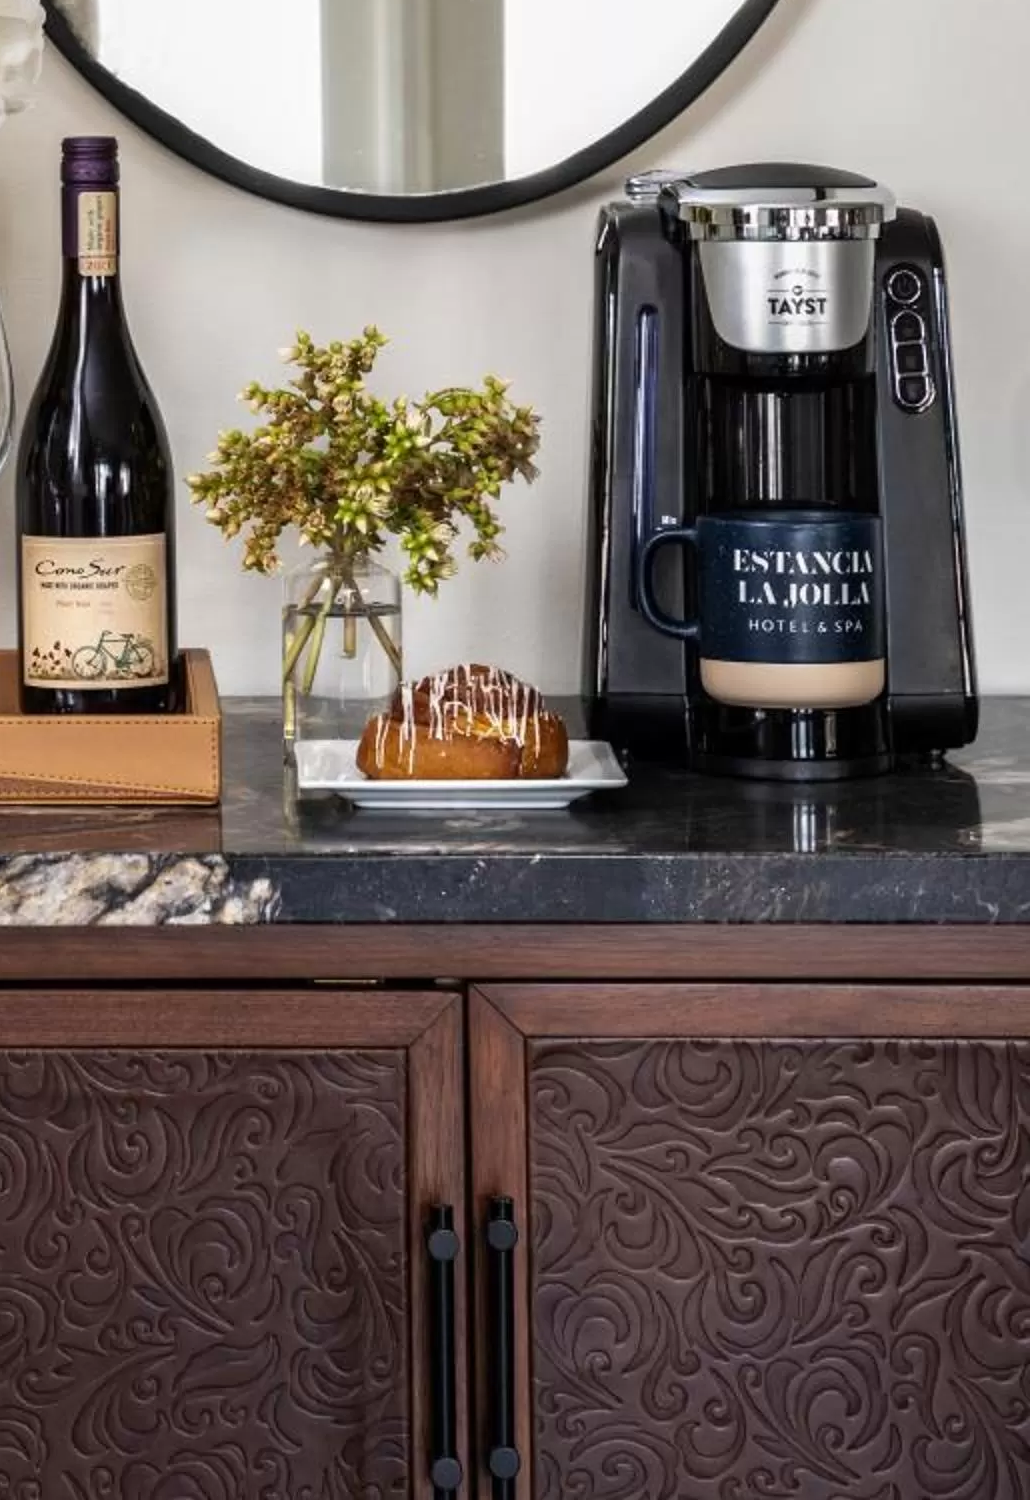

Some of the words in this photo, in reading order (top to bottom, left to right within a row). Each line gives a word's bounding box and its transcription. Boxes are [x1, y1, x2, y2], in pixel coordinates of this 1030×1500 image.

[767, 297, 827, 315] TAYST
[35, 560, 85, 577] Cono
[80, 560, 127, 579] Sur
[733, 549, 874, 575] ESTANCIA
[738, 579, 778, 605] LA
[782, 581, 870, 609] JOLLA
[748, 618, 810, 634] HOTEL
[817, 621, 828, 634] &
[834, 618, 864, 634] SPA
